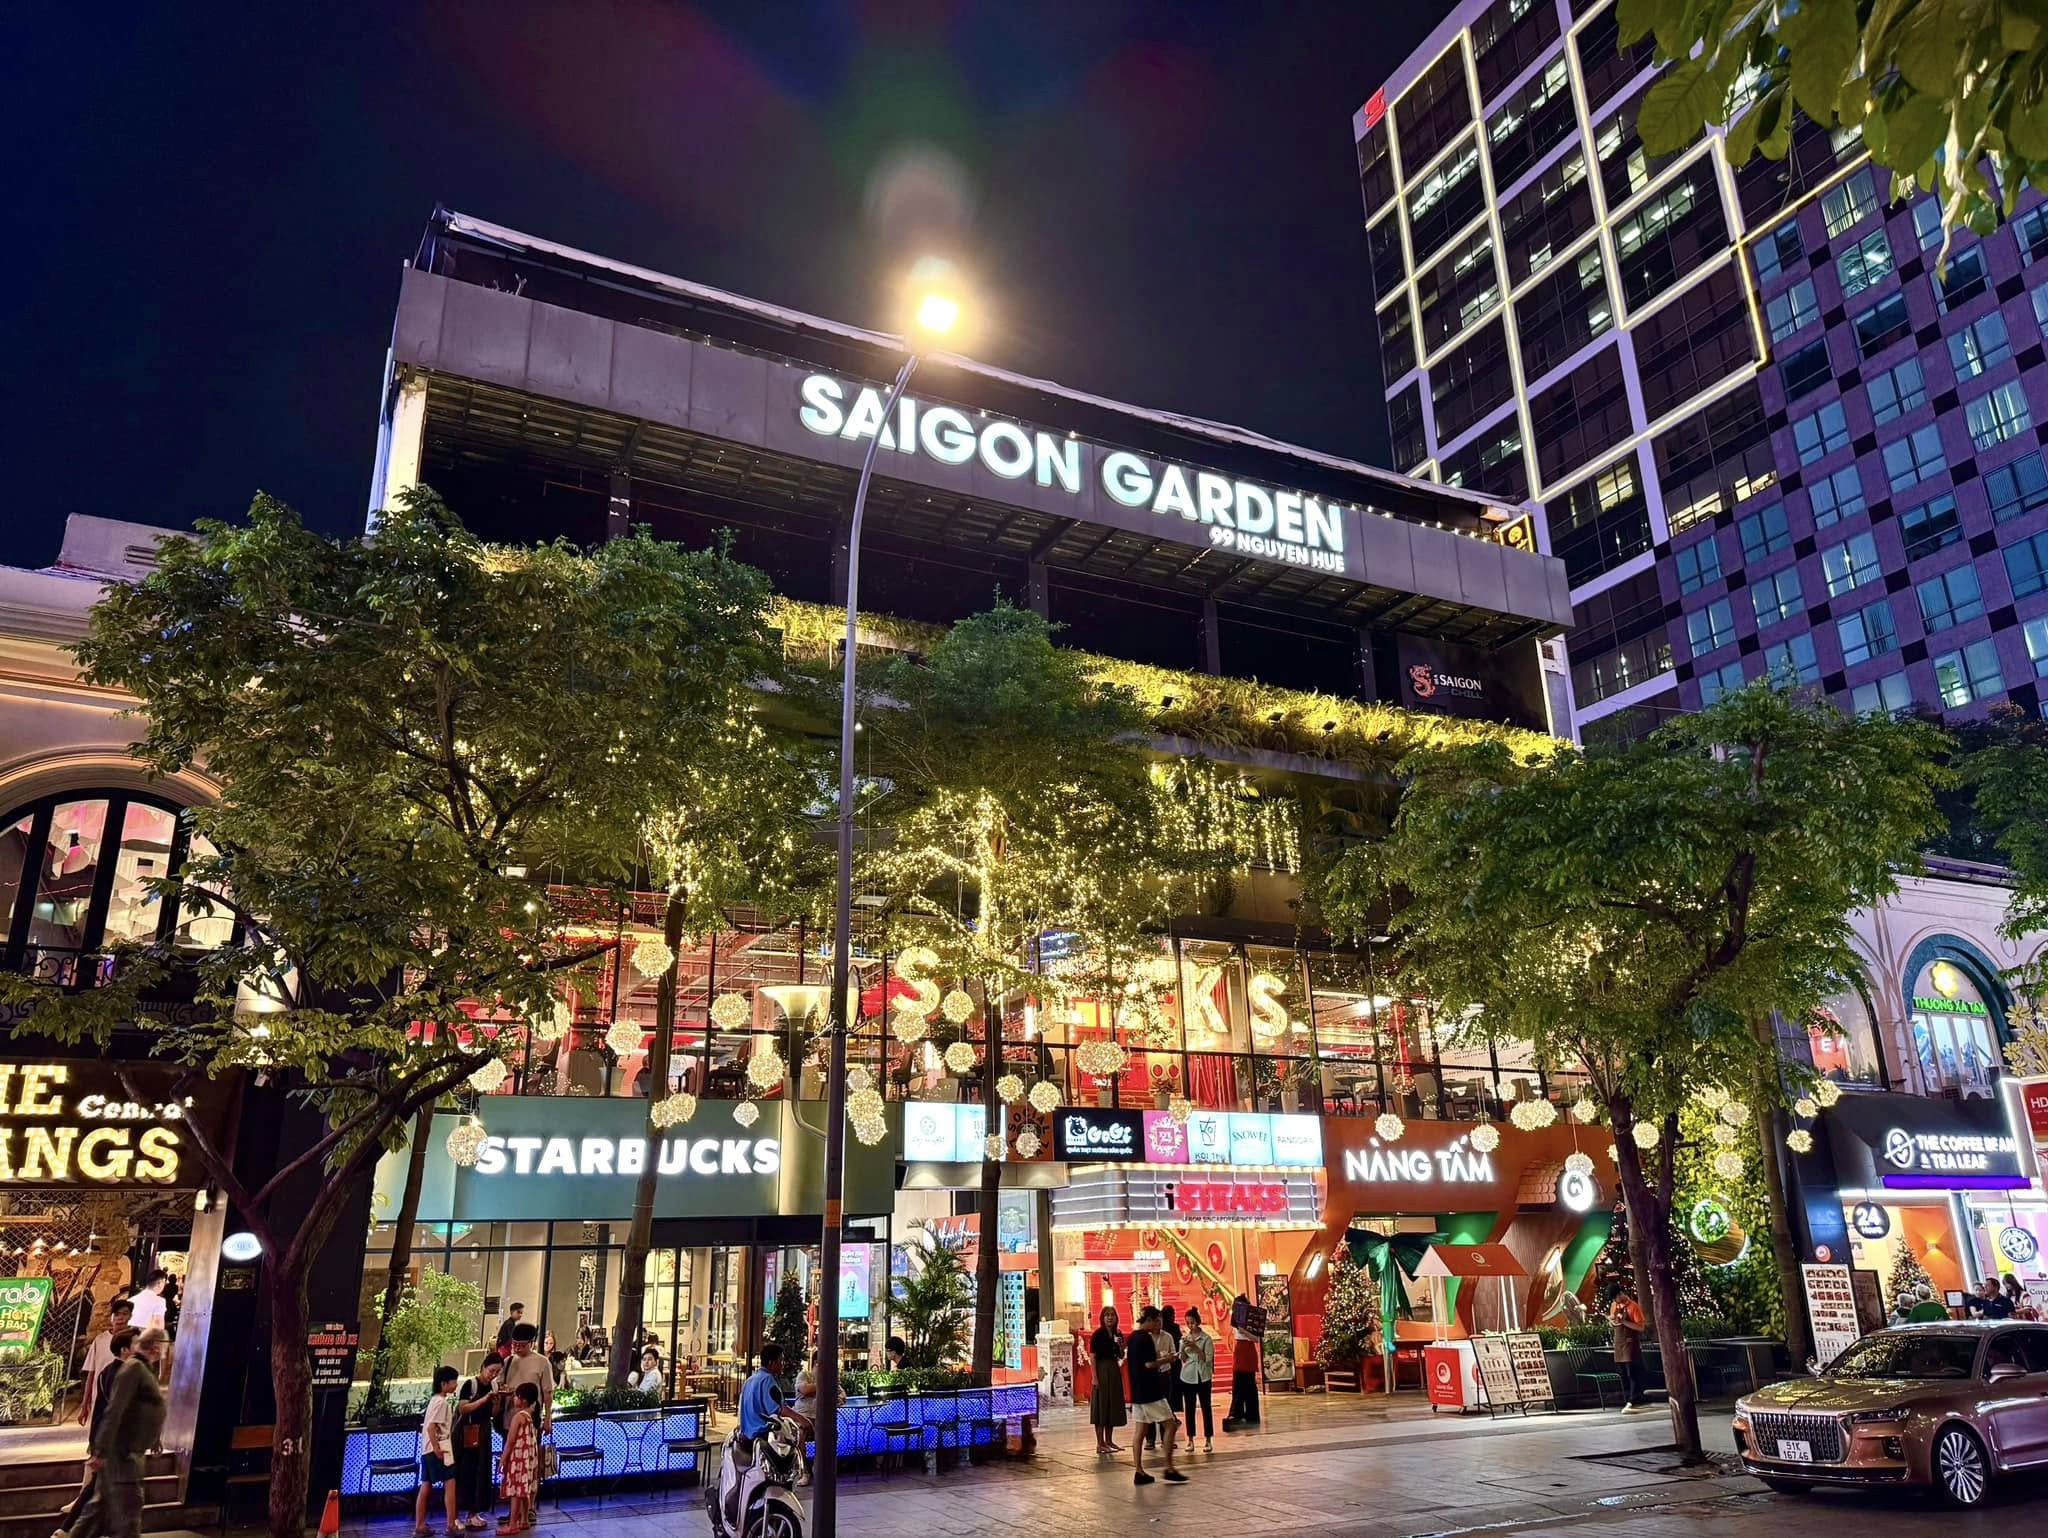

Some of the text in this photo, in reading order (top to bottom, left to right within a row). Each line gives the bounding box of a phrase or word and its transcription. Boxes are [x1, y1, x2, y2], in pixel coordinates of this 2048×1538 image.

[799, 374, 1344, 552] SAIGON GARDEN
[1209, 525, 1345, 573] 99 NGUYEN HUE
[475, 1137, 779, 1175] STARBUCKS
[1786, 1441, 1801, 1451] 51K
